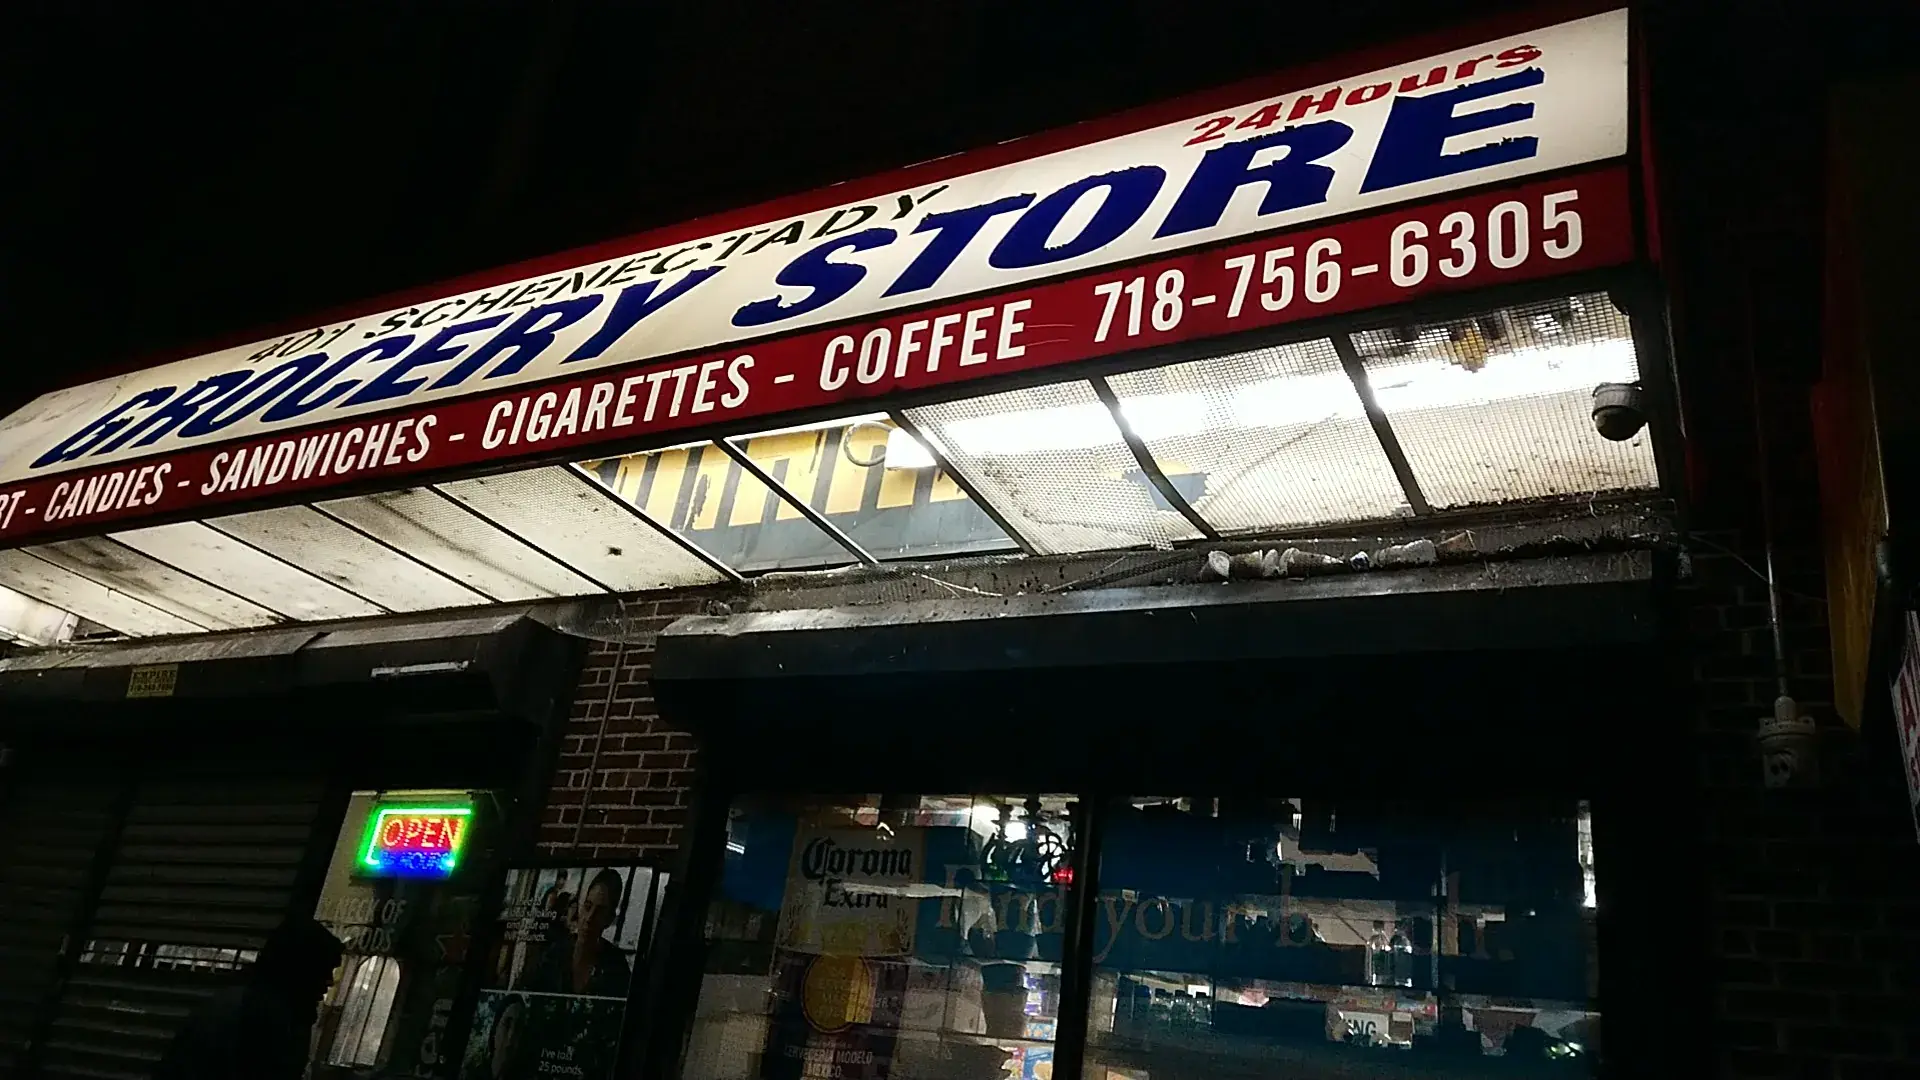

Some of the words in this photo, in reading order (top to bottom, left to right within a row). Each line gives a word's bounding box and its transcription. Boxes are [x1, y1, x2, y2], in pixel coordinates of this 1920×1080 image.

[29, 266, 725, 469] GROCERY
[732, 67, 1545, 328] STORE
[246, 322, 356, 363] 401
[363, 184, 949, 339] SCHENECTADY
[44, 463, 172, 522] CANDIES
[201, 414, 437, 496] SANDWICHES
[481, 354, 755, 450] CIGARETTES
[819, 299, 1033, 392] COFFEE
[1094, 189, 1585, 343] 718-756-6305
[383, 818, 464, 849] OPEN
[801, 836, 912, 885] Corona
[823, 879, 888, 908] Extra
[1093, 896, 1241, 965] your
